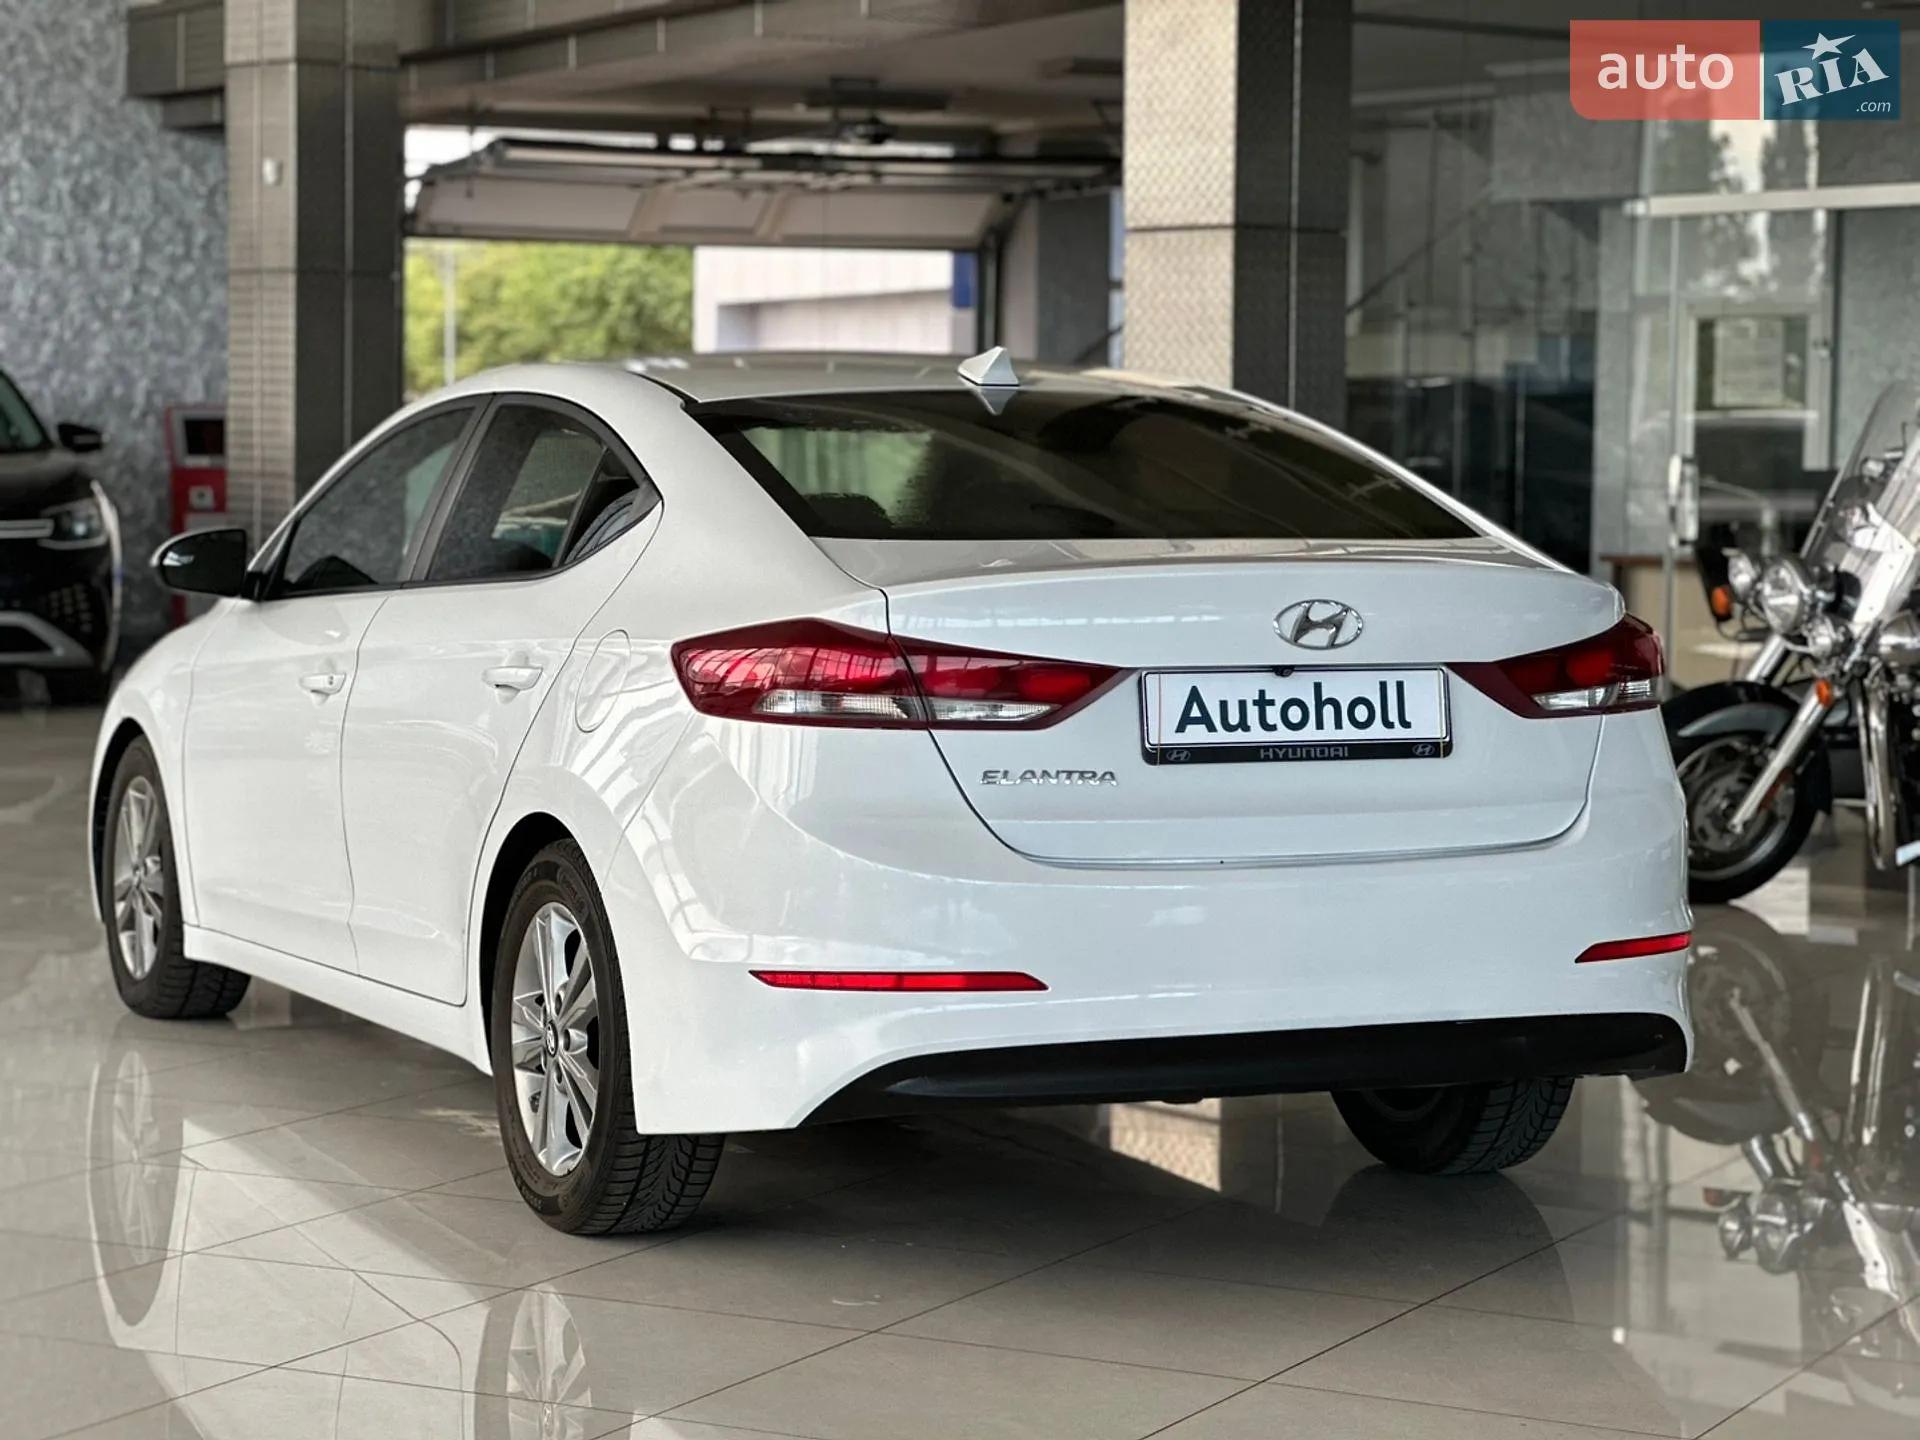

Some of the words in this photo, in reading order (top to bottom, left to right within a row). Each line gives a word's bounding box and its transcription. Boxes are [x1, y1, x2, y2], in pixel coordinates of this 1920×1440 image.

[1174, 680, 1412, 733] Autoholl
[1259, 745, 1349, 760] HYUNDAI
[979, 769, 1118, 786] ELANTRA
